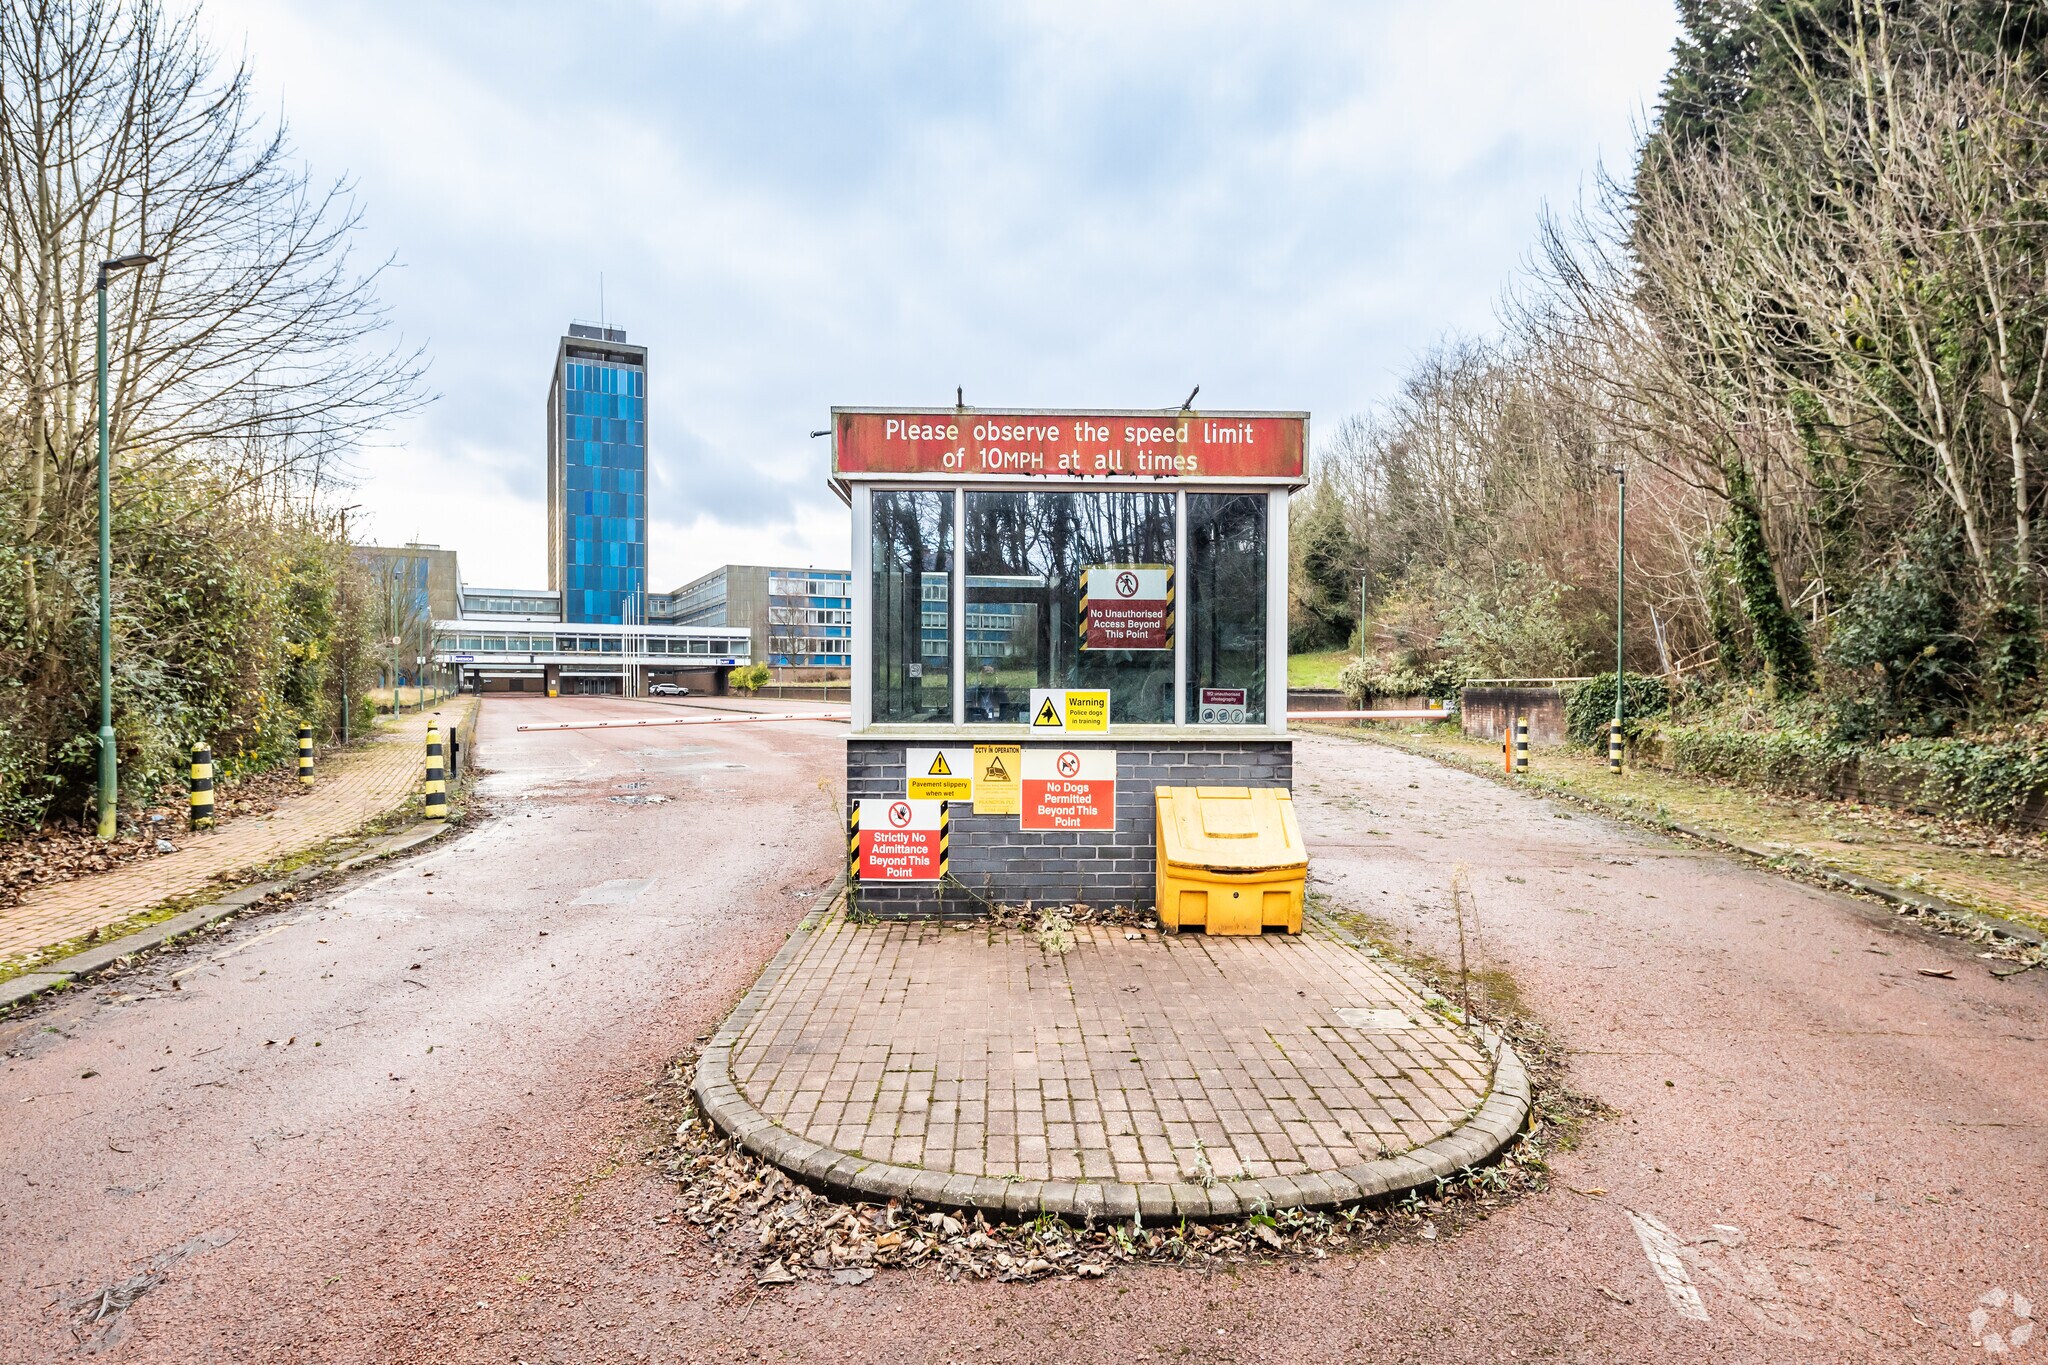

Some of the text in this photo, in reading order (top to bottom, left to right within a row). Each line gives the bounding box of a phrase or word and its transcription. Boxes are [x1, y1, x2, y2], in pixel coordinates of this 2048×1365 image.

[886, 420, 1254, 444] Please observe the speed limit
[943, 448, 1198, 471] of 10MPH at all times
[1090, 609, 1163, 618] No Unauthorised
[1093, 620, 1161, 630] Access Beyond
[1105, 630, 1149, 639] This Point
[1068, 698, 1105, 708] Warning
[911, 780, 942, 788] Pavement
[943, 780, 968, 789] slippery
[1047, 782, 1089, 794] No Dogs
[1044, 793, 1092, 804] Permitted
[1037, 805, 1099, 817] Beyond This
[1055, 817, 1081, 827] Point
[874, 832, 927, 845] Strictly No
[871, 844, 929, 854] Admittance
[869, 855, 931, 867] Beyond This
[886, 867, 913, 877] Point
